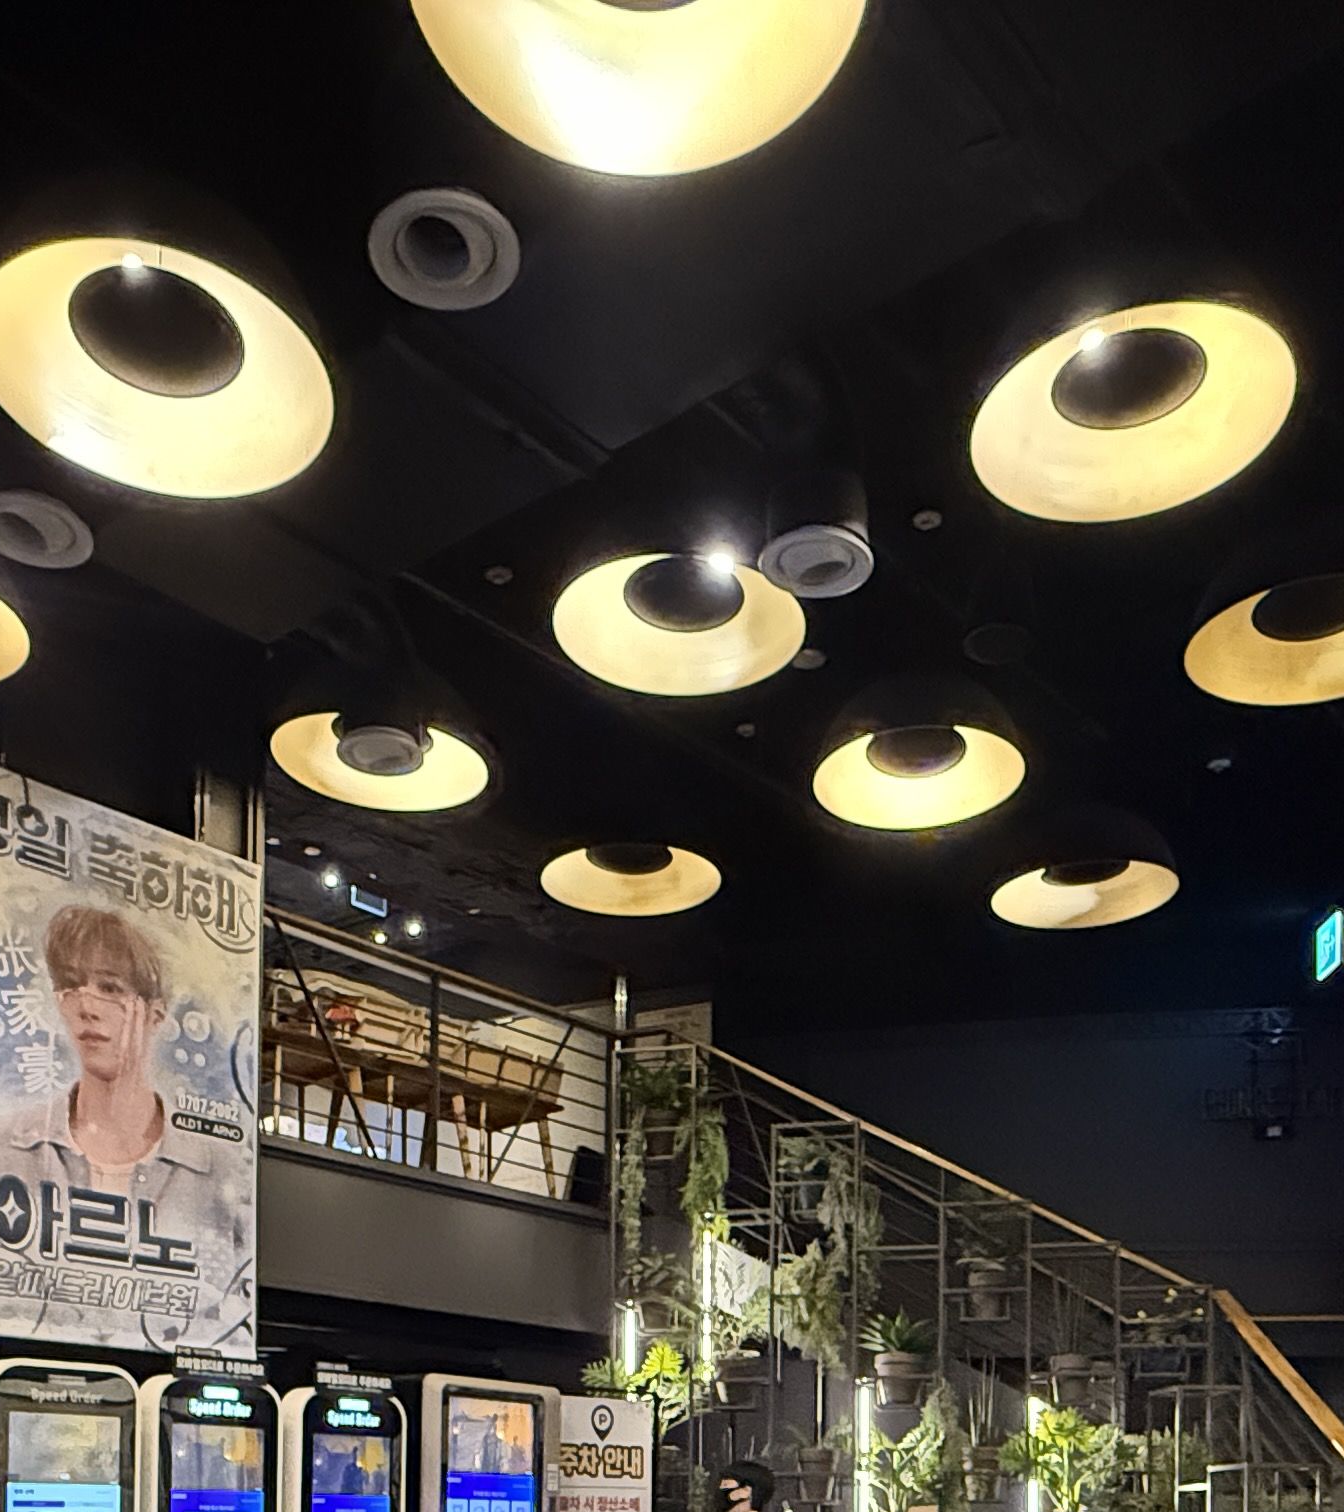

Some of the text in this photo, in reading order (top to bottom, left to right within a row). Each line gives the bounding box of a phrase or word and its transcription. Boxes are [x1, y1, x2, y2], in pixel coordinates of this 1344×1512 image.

[89, 831, 243, 938] 축하해
[177, 1092, 242, 1122] 0707.2002
[174, 1116, 202, 1133] ALD1
[211, 1123, 242, 1141] ARNO
[603, 1445, 644, 1479] 안내
